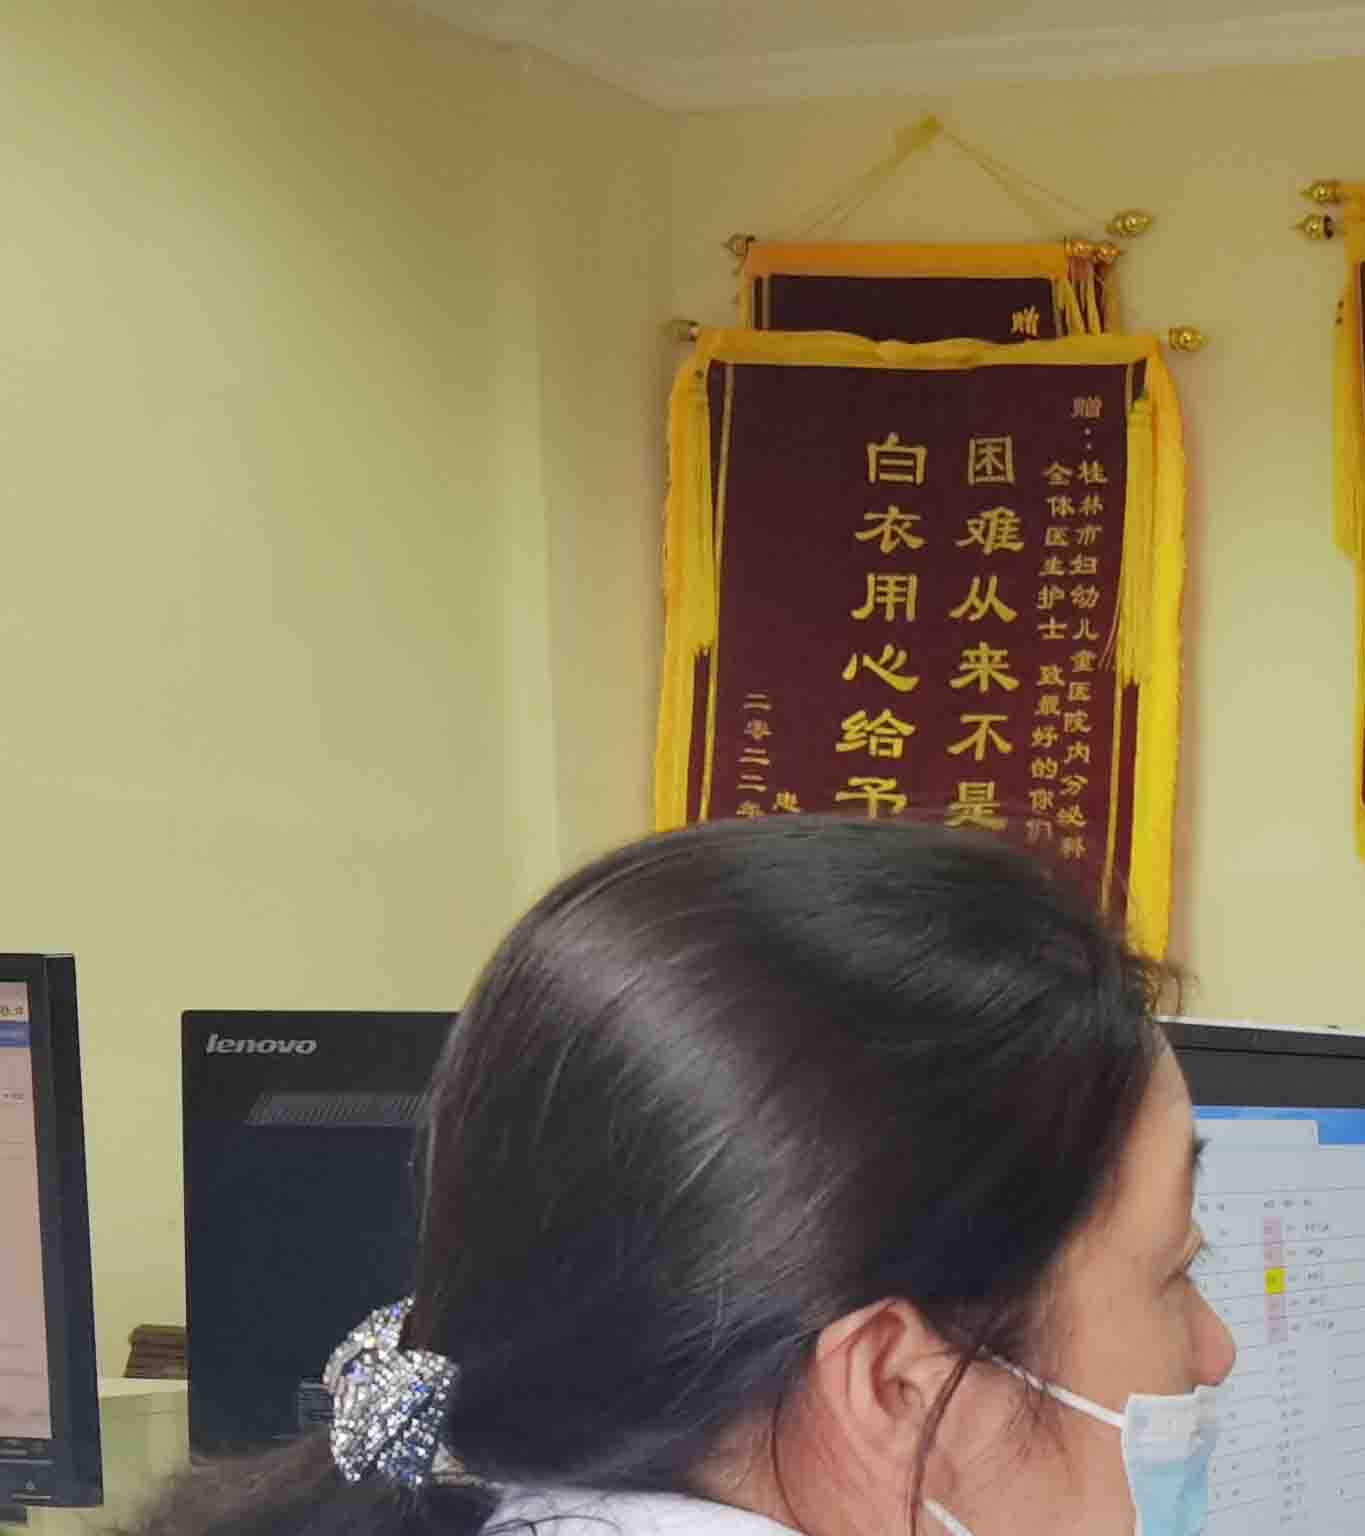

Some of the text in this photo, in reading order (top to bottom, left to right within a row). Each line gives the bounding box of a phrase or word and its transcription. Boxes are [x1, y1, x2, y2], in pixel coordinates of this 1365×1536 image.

[944, 433, 1026, 832] 困难从来不是
[206, 1032, 318, 1055] lenovo
